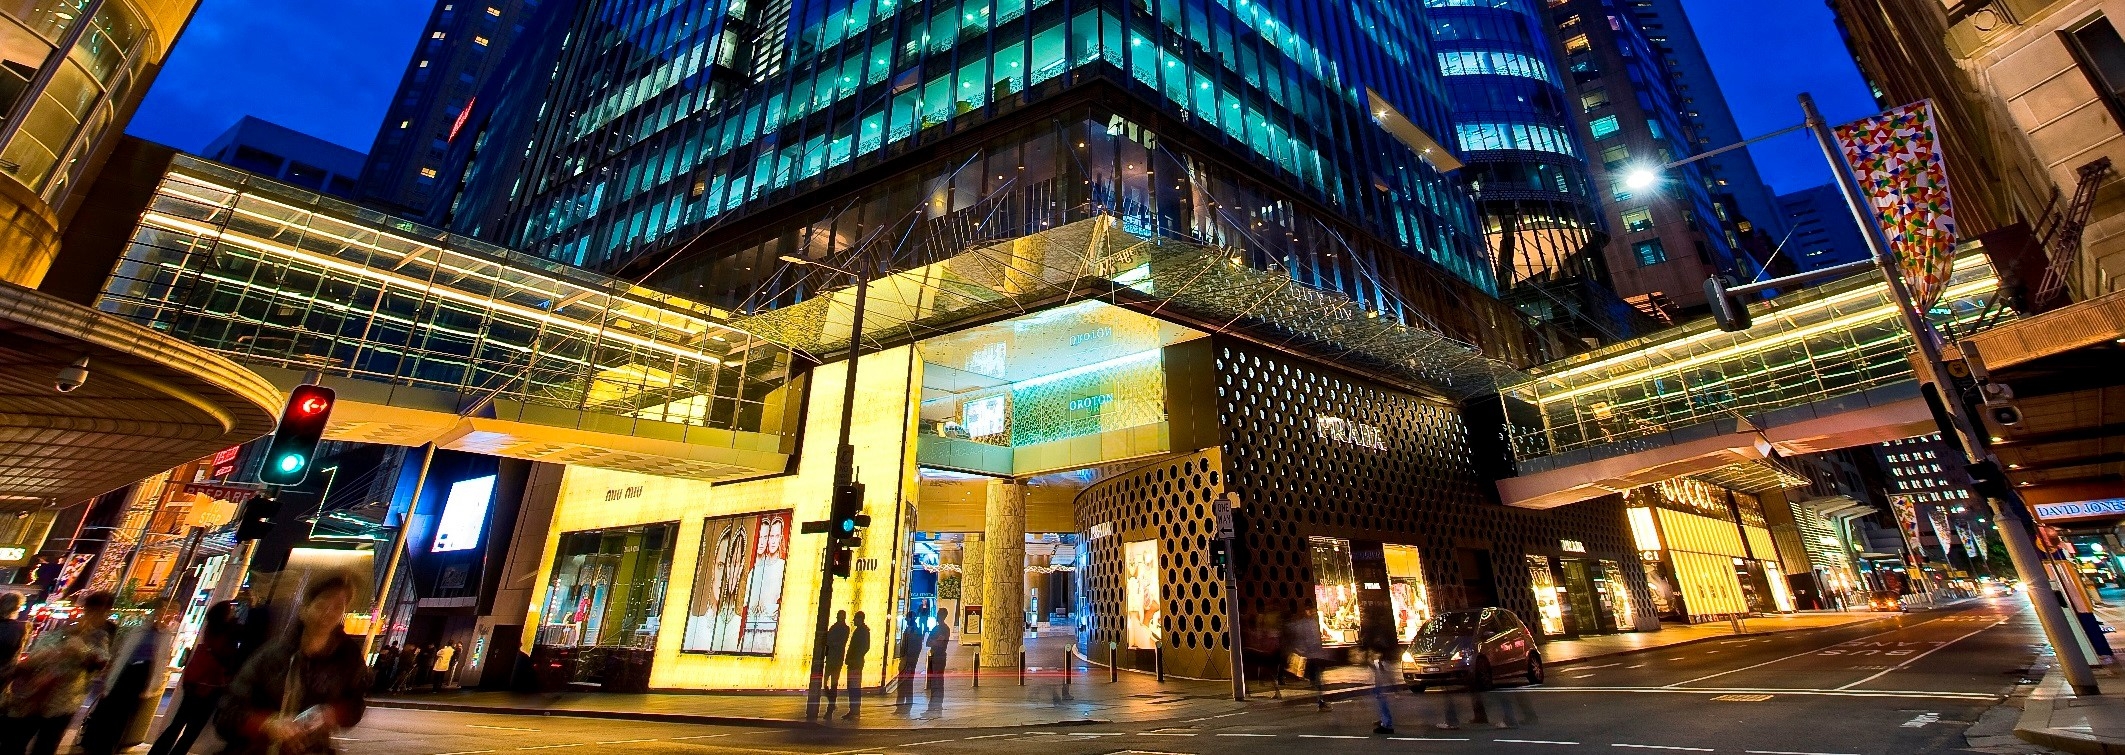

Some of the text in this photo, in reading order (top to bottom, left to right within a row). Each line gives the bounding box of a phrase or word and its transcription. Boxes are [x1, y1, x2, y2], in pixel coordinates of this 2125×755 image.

[1069, 393, 1113, 411] OROTON
[1316, 413, 1387, 451] PRADA
[1661, 477, 1714, 510] GUCCI
[1217, 503, 1229, 512] ONE
[2038, 504, 2080, 517] DAVID
[199, 512, 221, 524] STOP
[1218, 514, 1231, 524] WAY
